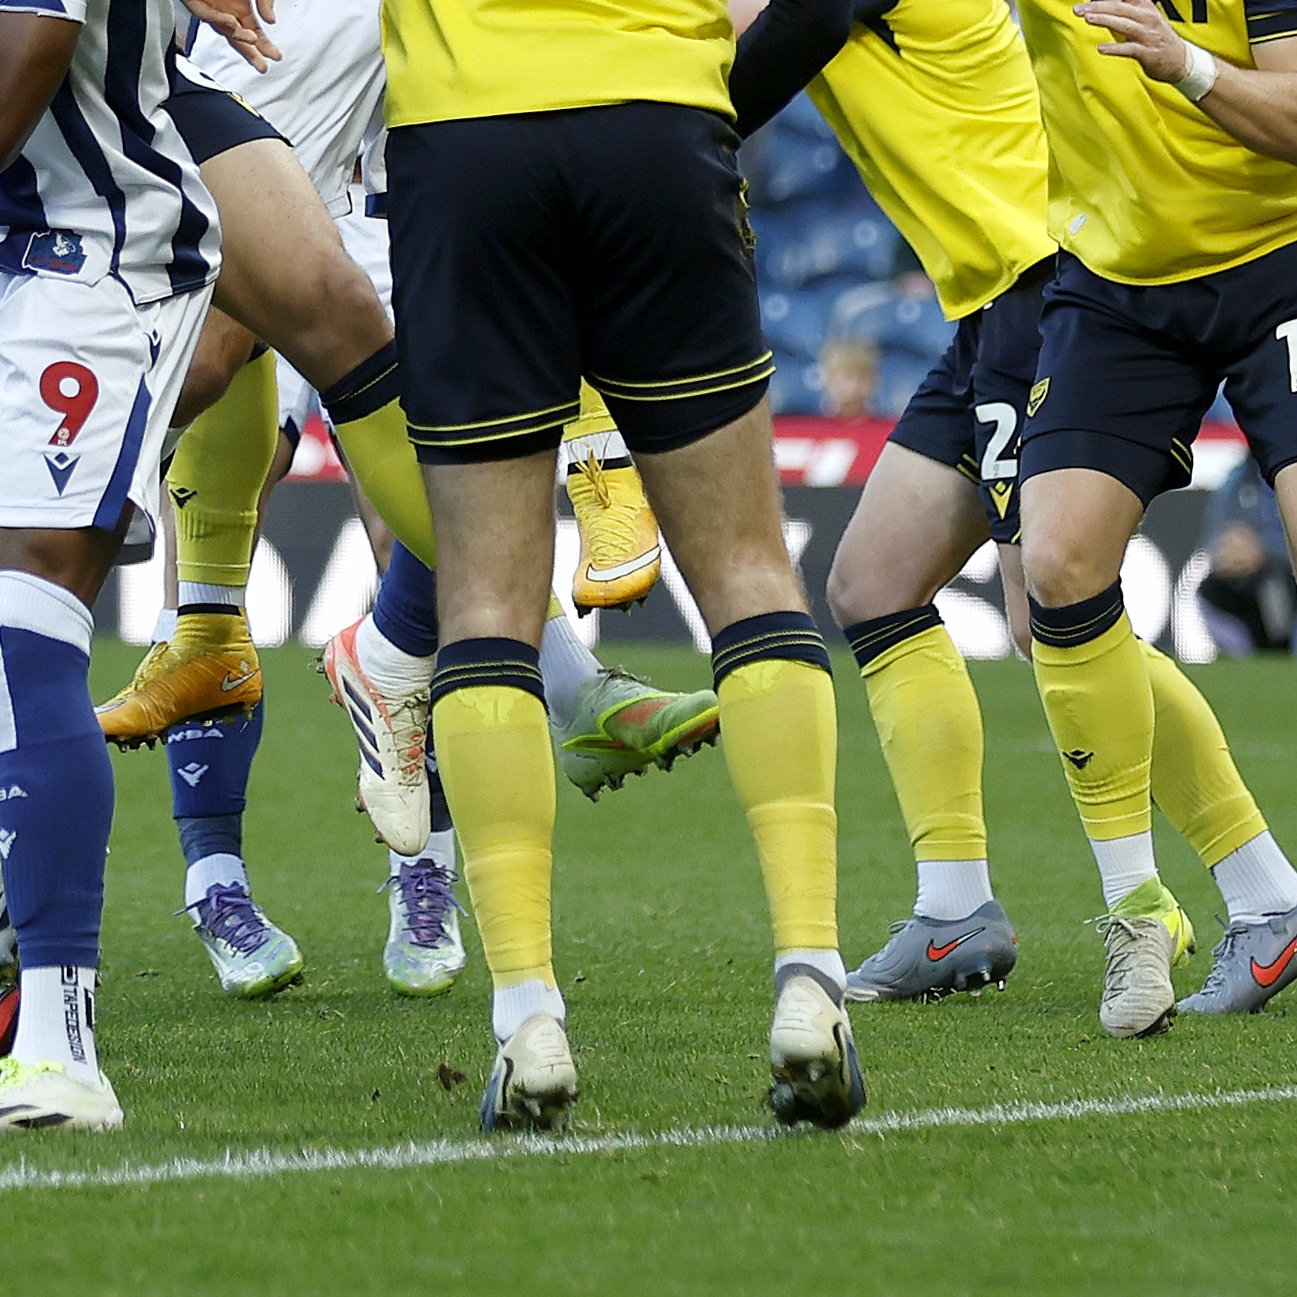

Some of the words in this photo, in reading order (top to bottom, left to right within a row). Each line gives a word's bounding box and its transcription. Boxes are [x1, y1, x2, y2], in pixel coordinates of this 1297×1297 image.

[39, 360, 100, 448] 9
[974, 402, 1022, 481] 2
[63, 986, 88, 1065] TAPEDESIGN
